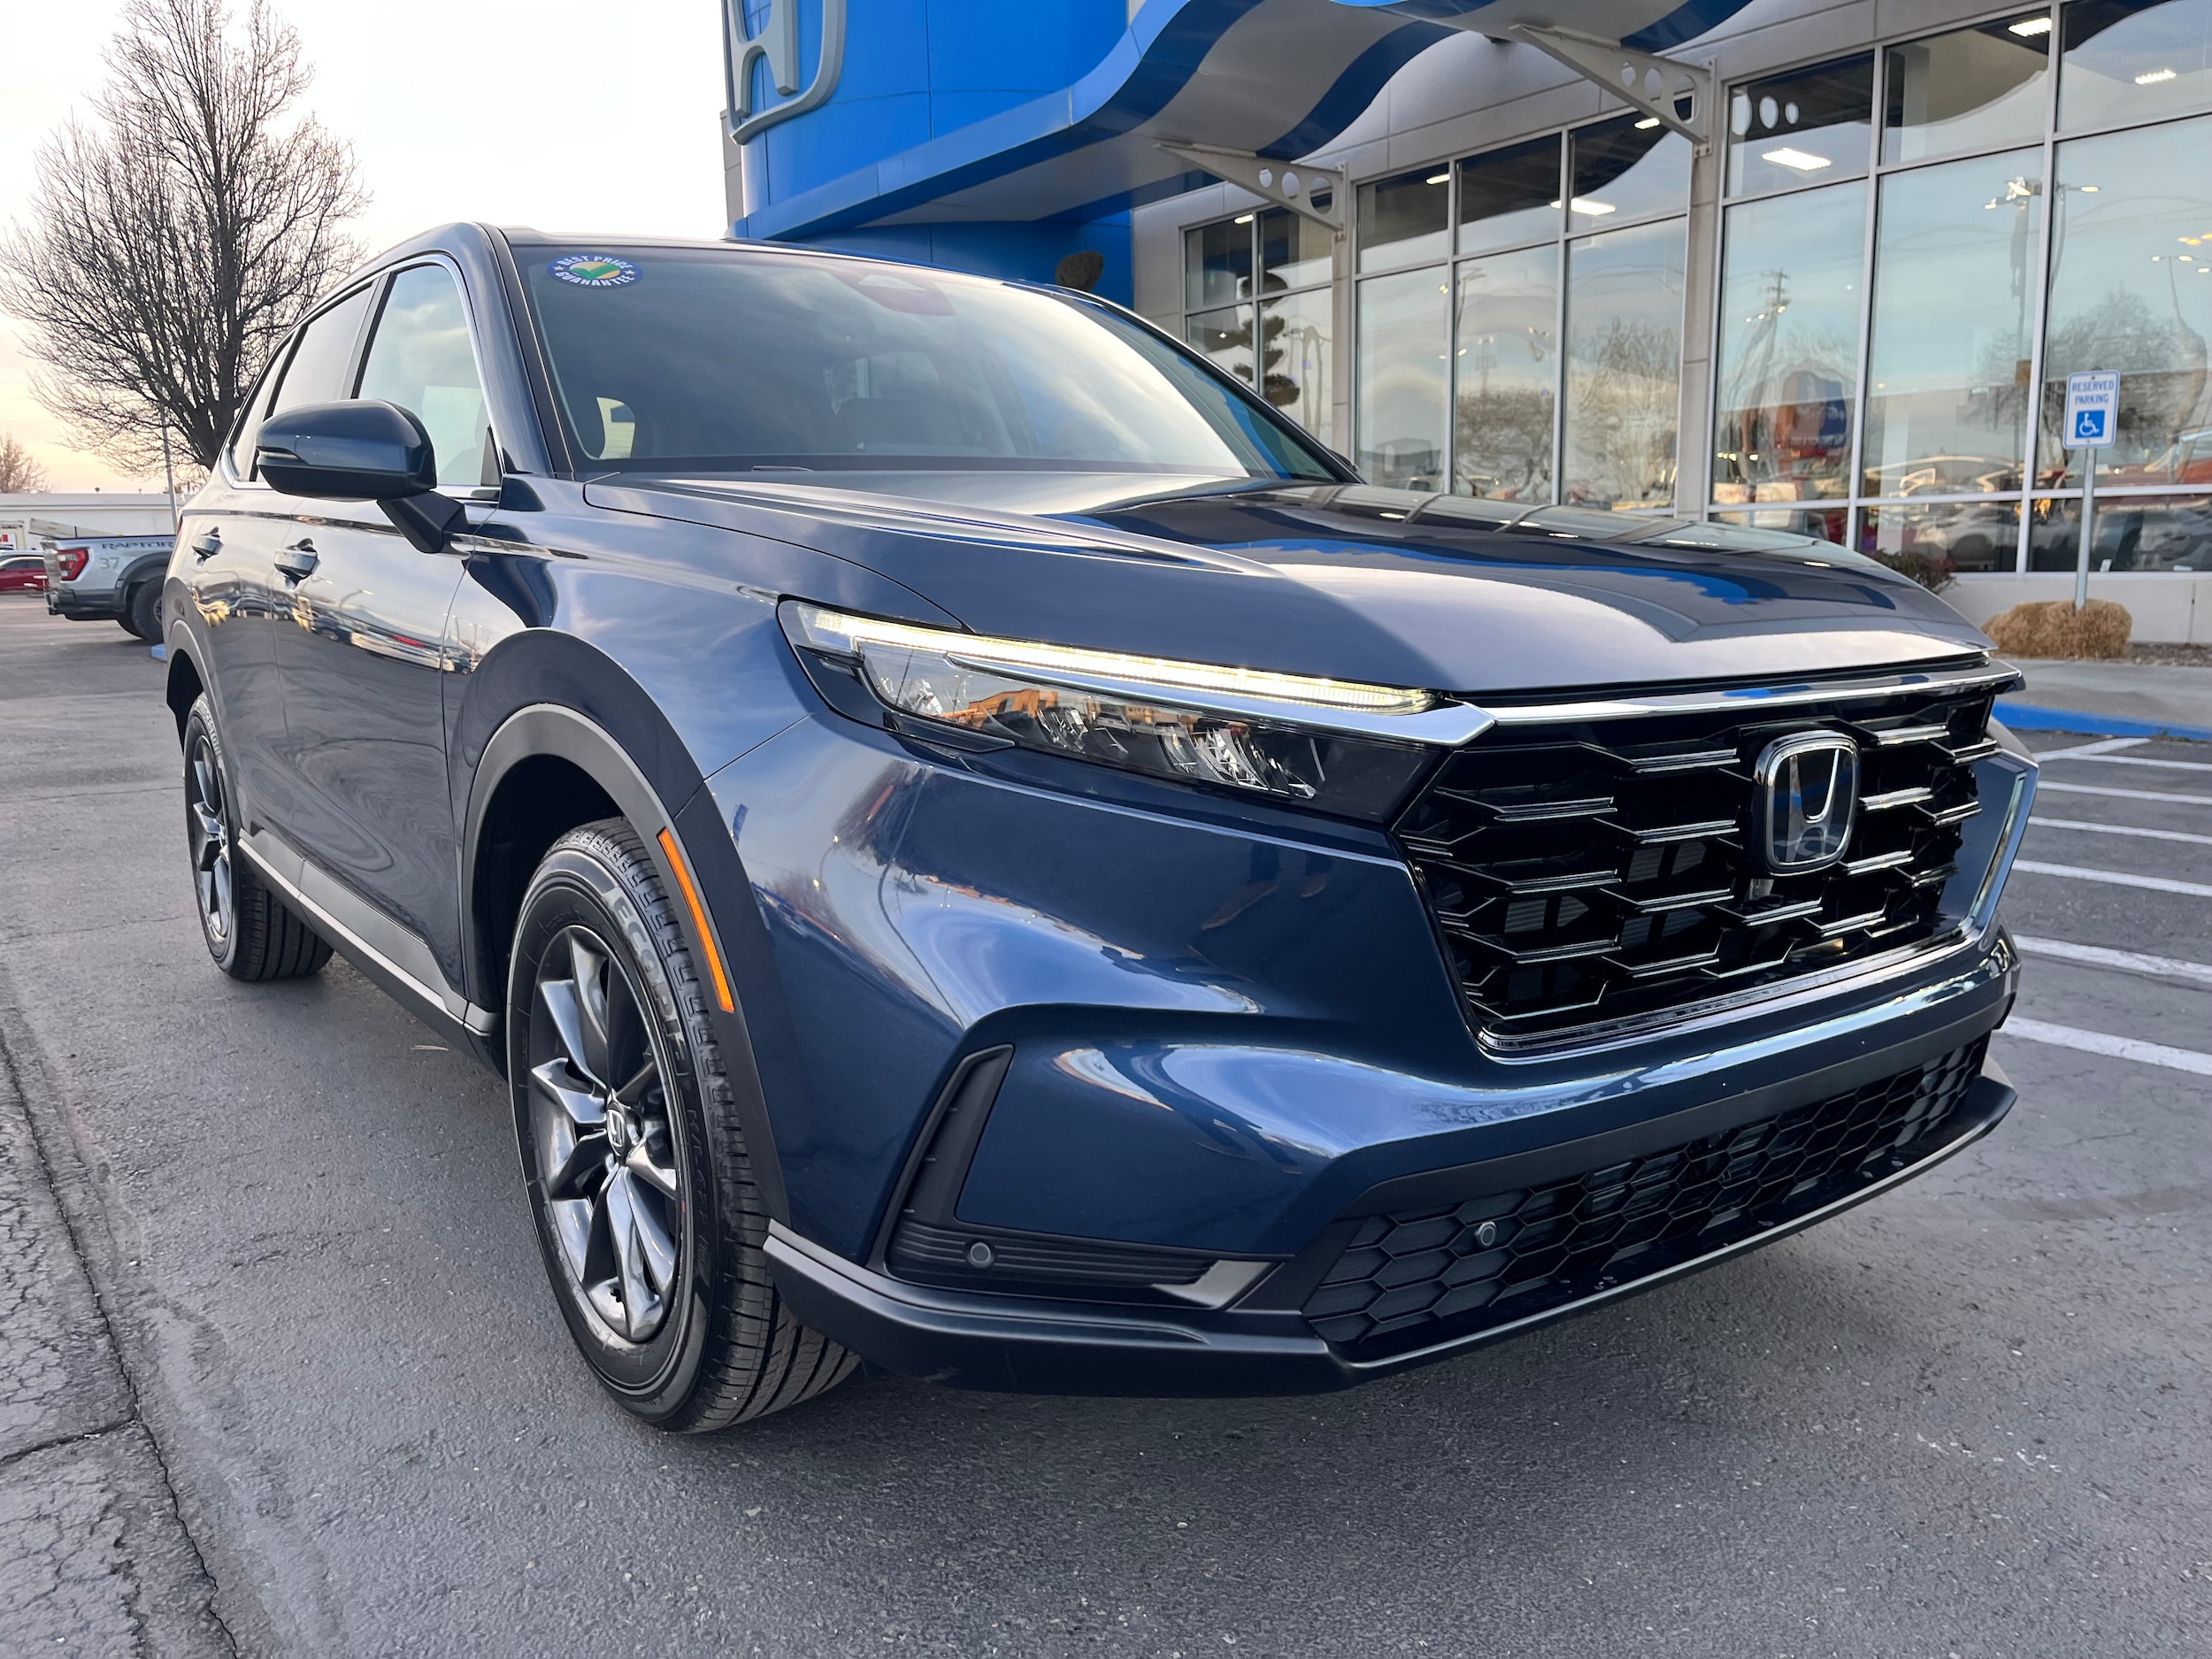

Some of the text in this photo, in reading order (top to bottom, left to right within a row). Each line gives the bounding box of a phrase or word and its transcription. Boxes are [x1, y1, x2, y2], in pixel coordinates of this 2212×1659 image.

[556, 255, 634, 269] BEST PRICE
[555, 272, 635, 287] GUARANTEE
[2072, 380, 2114, 392] RESERVED
[2075, 394, 2108, 404] PARKING
[102, 541, 174, 549] RAPTOR
[99, 557, 119, 570] 37
[613, 895, 688, 1063] ECOPIA
